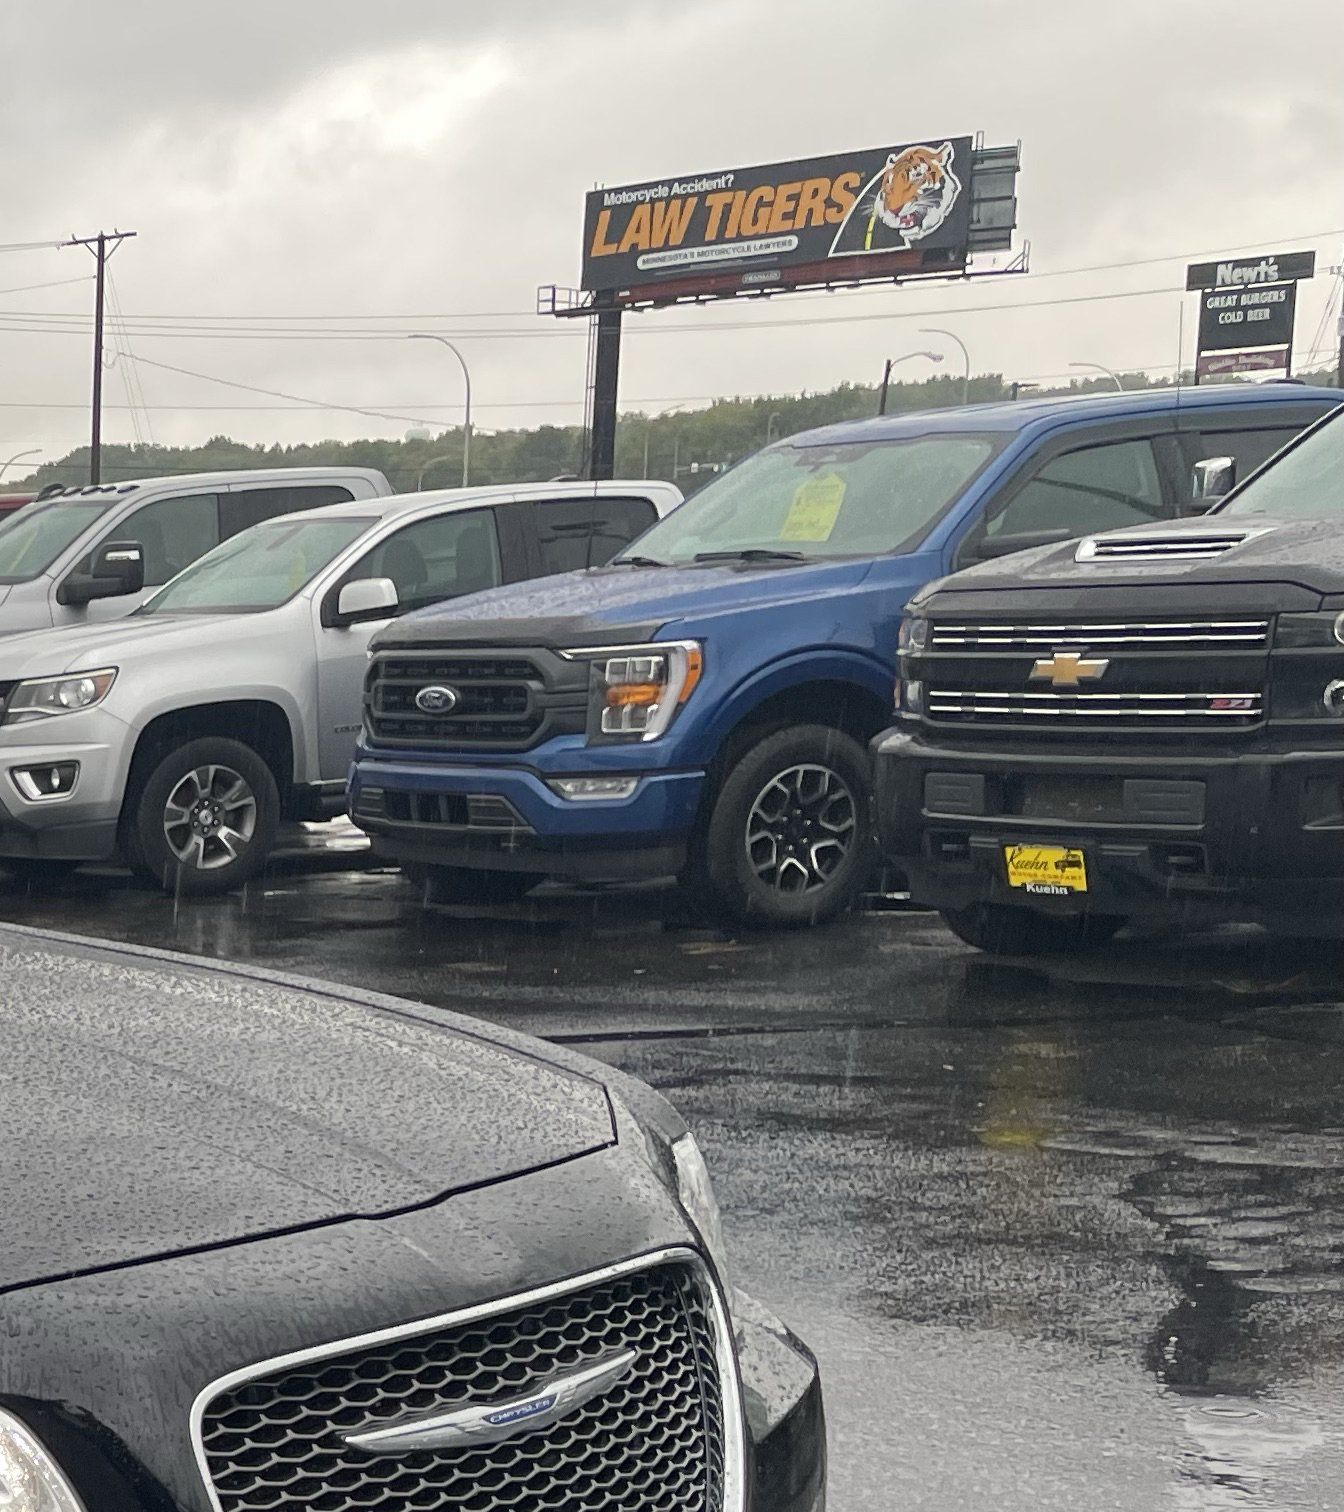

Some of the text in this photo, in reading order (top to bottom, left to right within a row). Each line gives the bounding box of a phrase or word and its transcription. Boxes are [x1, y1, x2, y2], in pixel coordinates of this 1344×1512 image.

[603, 172, 735, 207] Motorcycle Accident?
[590, 171, 862, 257] LAW TIGERS
[1215, 257, 1279, 286] Newt's
[1206, 294, 1238, 309] GREAT
[1218, 310, 1244, 325] COLD
[1026, 883, 1068, 895] Kuehn
